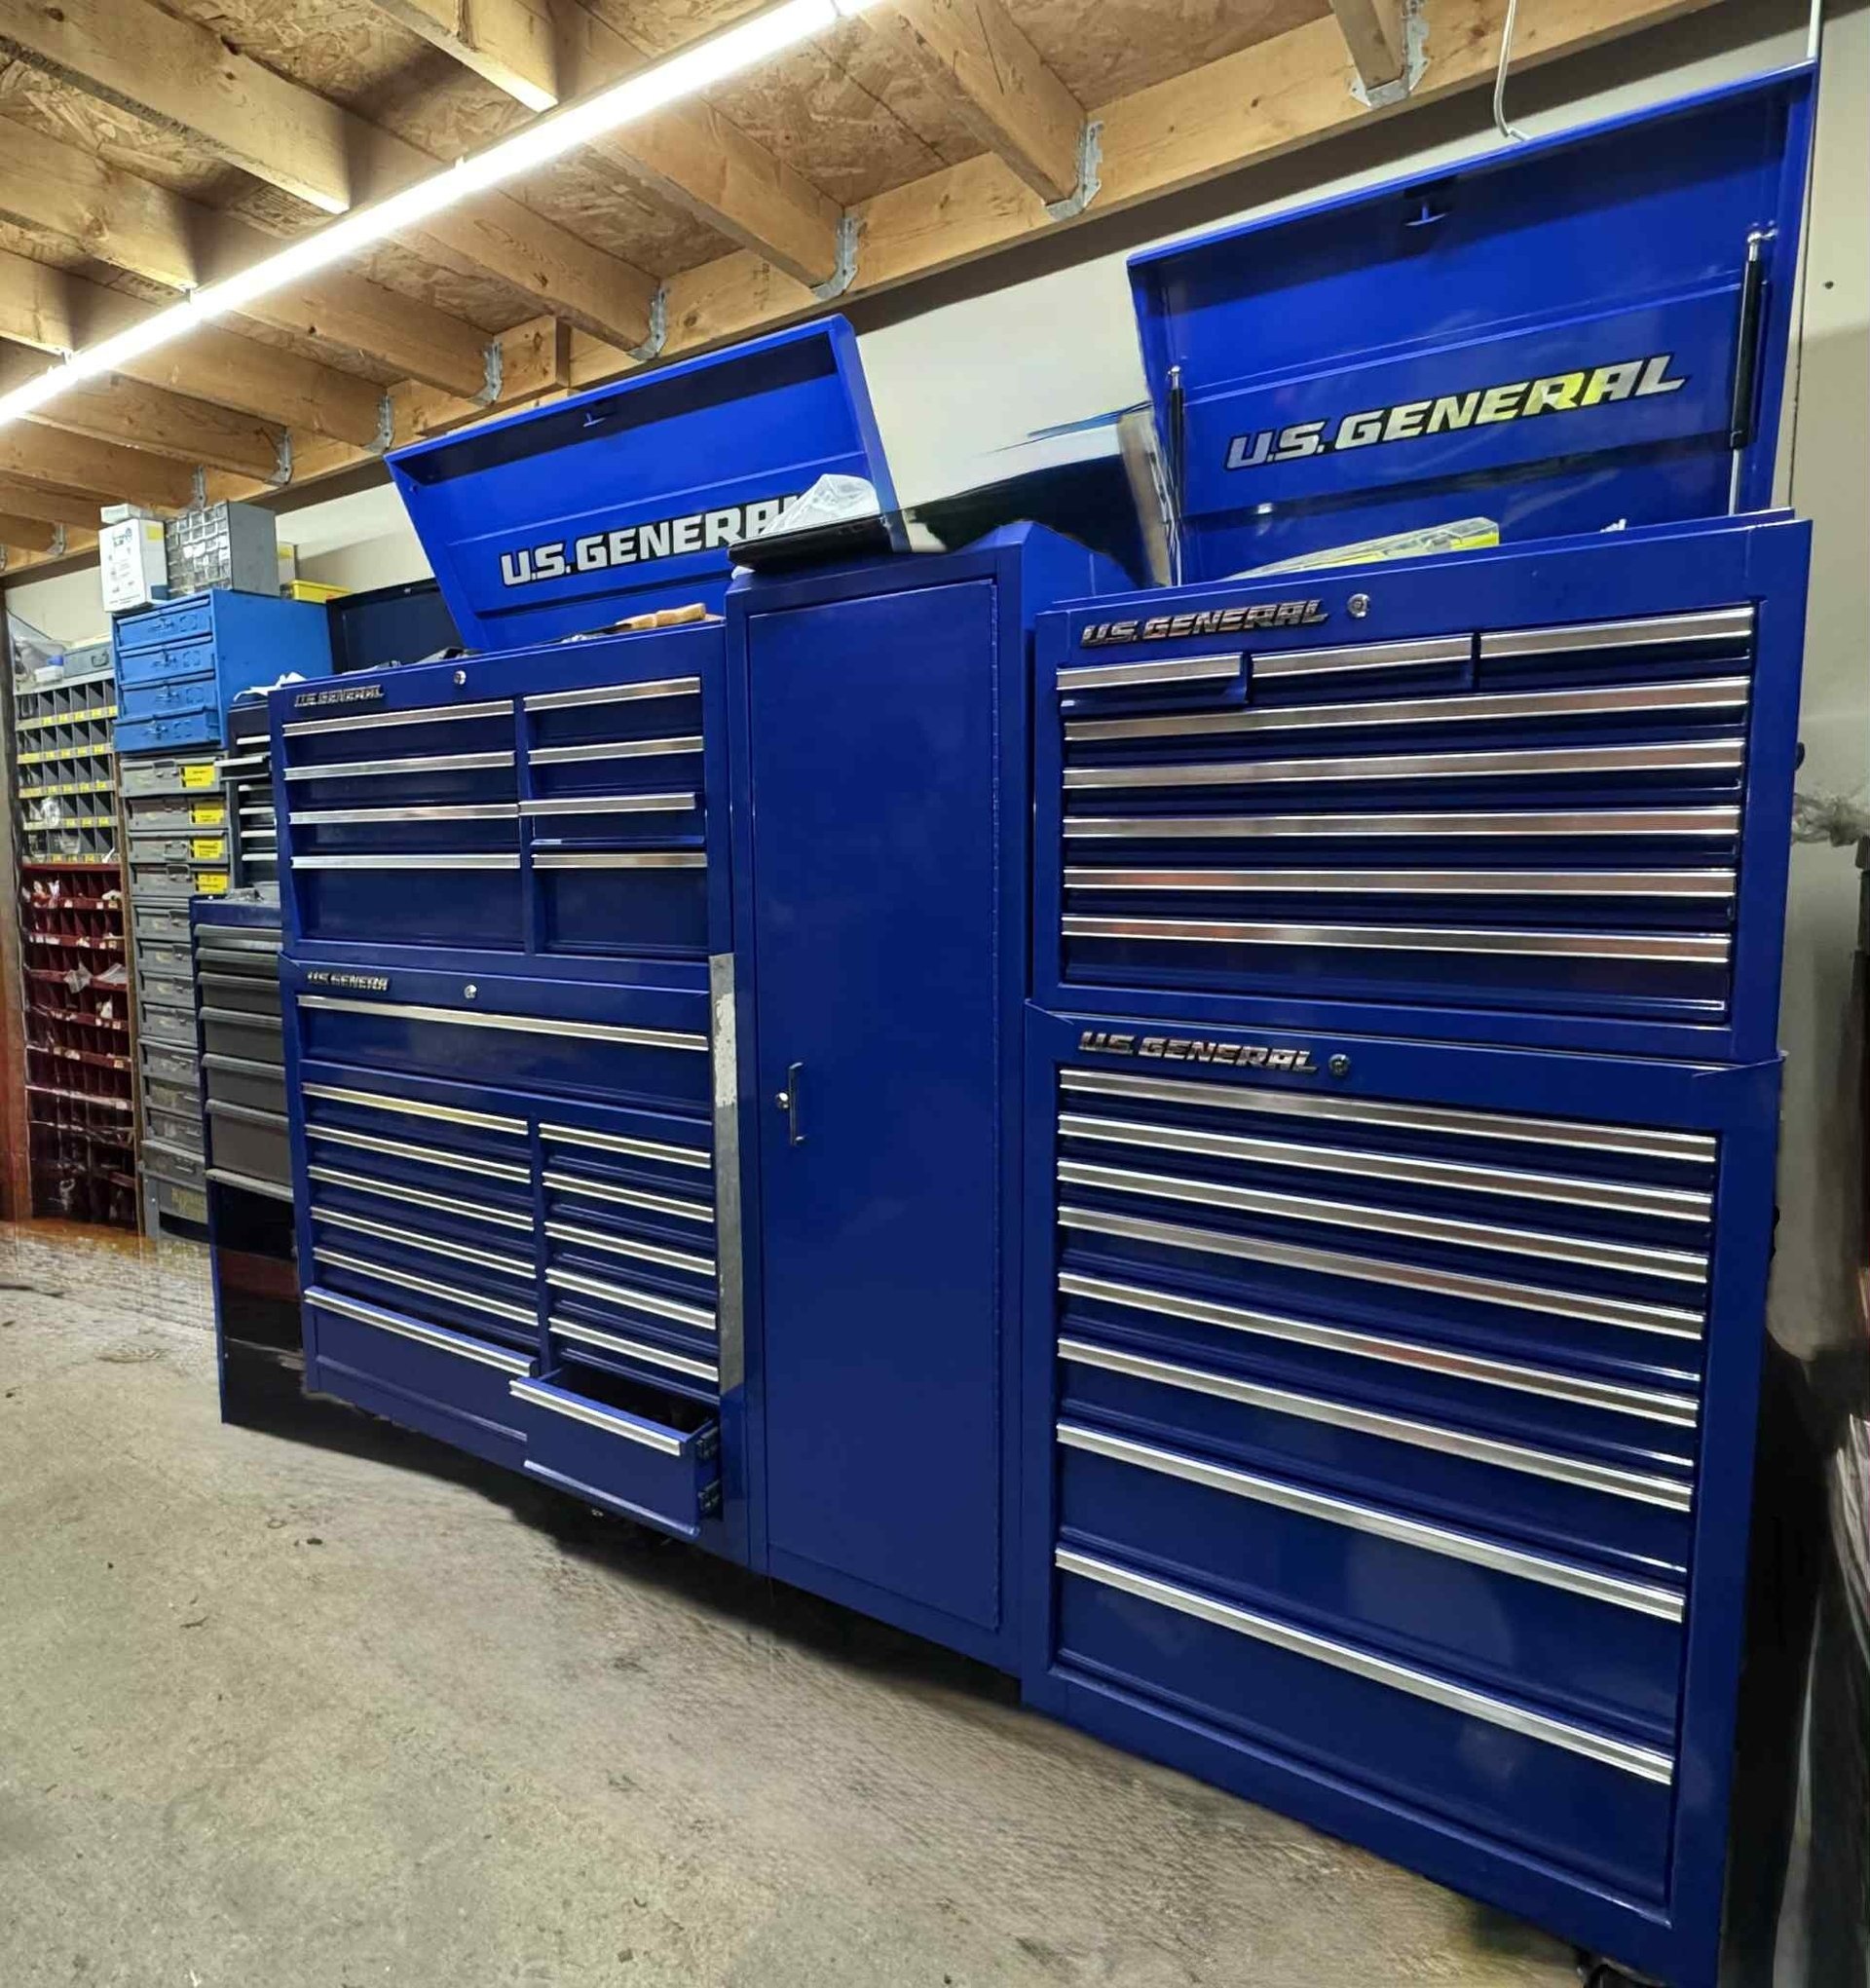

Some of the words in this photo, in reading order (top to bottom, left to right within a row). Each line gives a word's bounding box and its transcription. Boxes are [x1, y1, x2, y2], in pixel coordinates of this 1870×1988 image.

[1333, 355, 1687, 452] GENERAL
[1141, 599, 1329, 640] GENERAL
[1138, 1036, 1319, 1072] GENERAL
